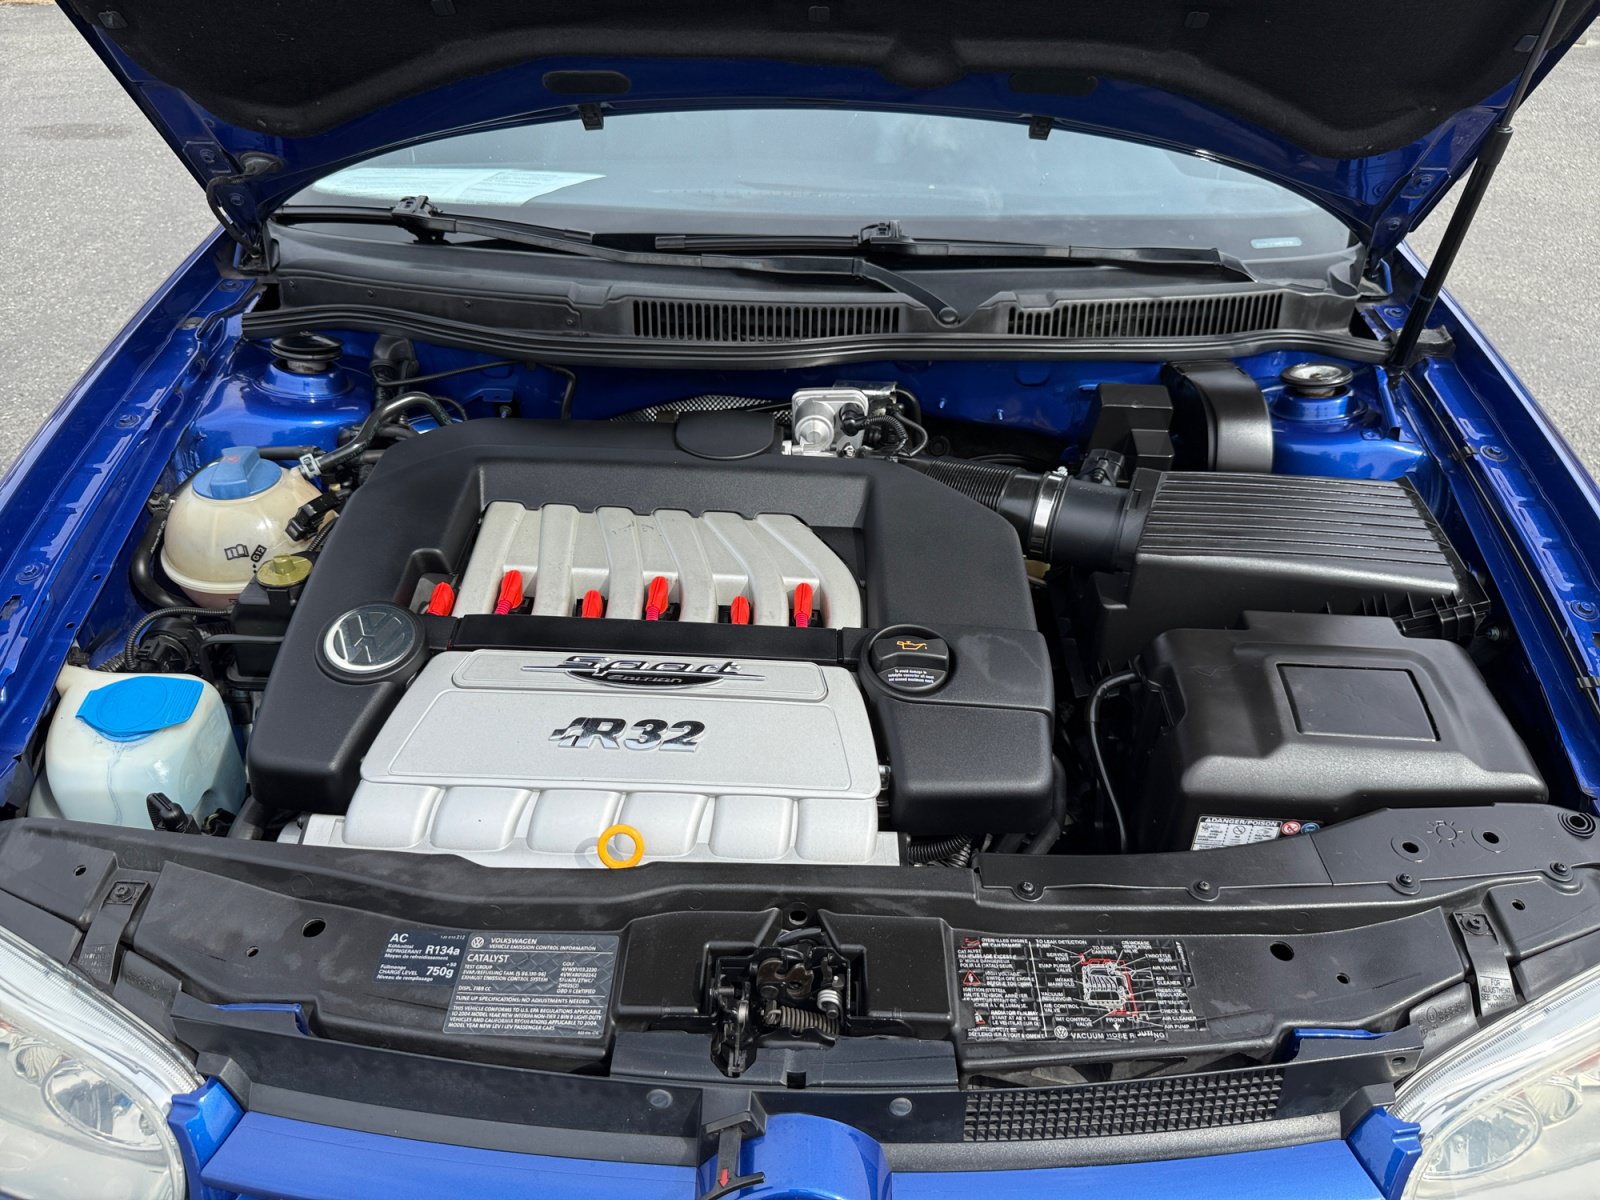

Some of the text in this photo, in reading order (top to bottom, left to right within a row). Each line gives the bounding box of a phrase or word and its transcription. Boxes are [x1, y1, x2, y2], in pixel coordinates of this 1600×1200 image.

[252, 546, 264, 560] G12
[549, 716, 706, 753] R32
[390, 933, 409, 943] AC
[425, 945, 460, 956] R134a
[467, 954, 510, 962] CATALYST
[426, 966, 454, 978] 750g
